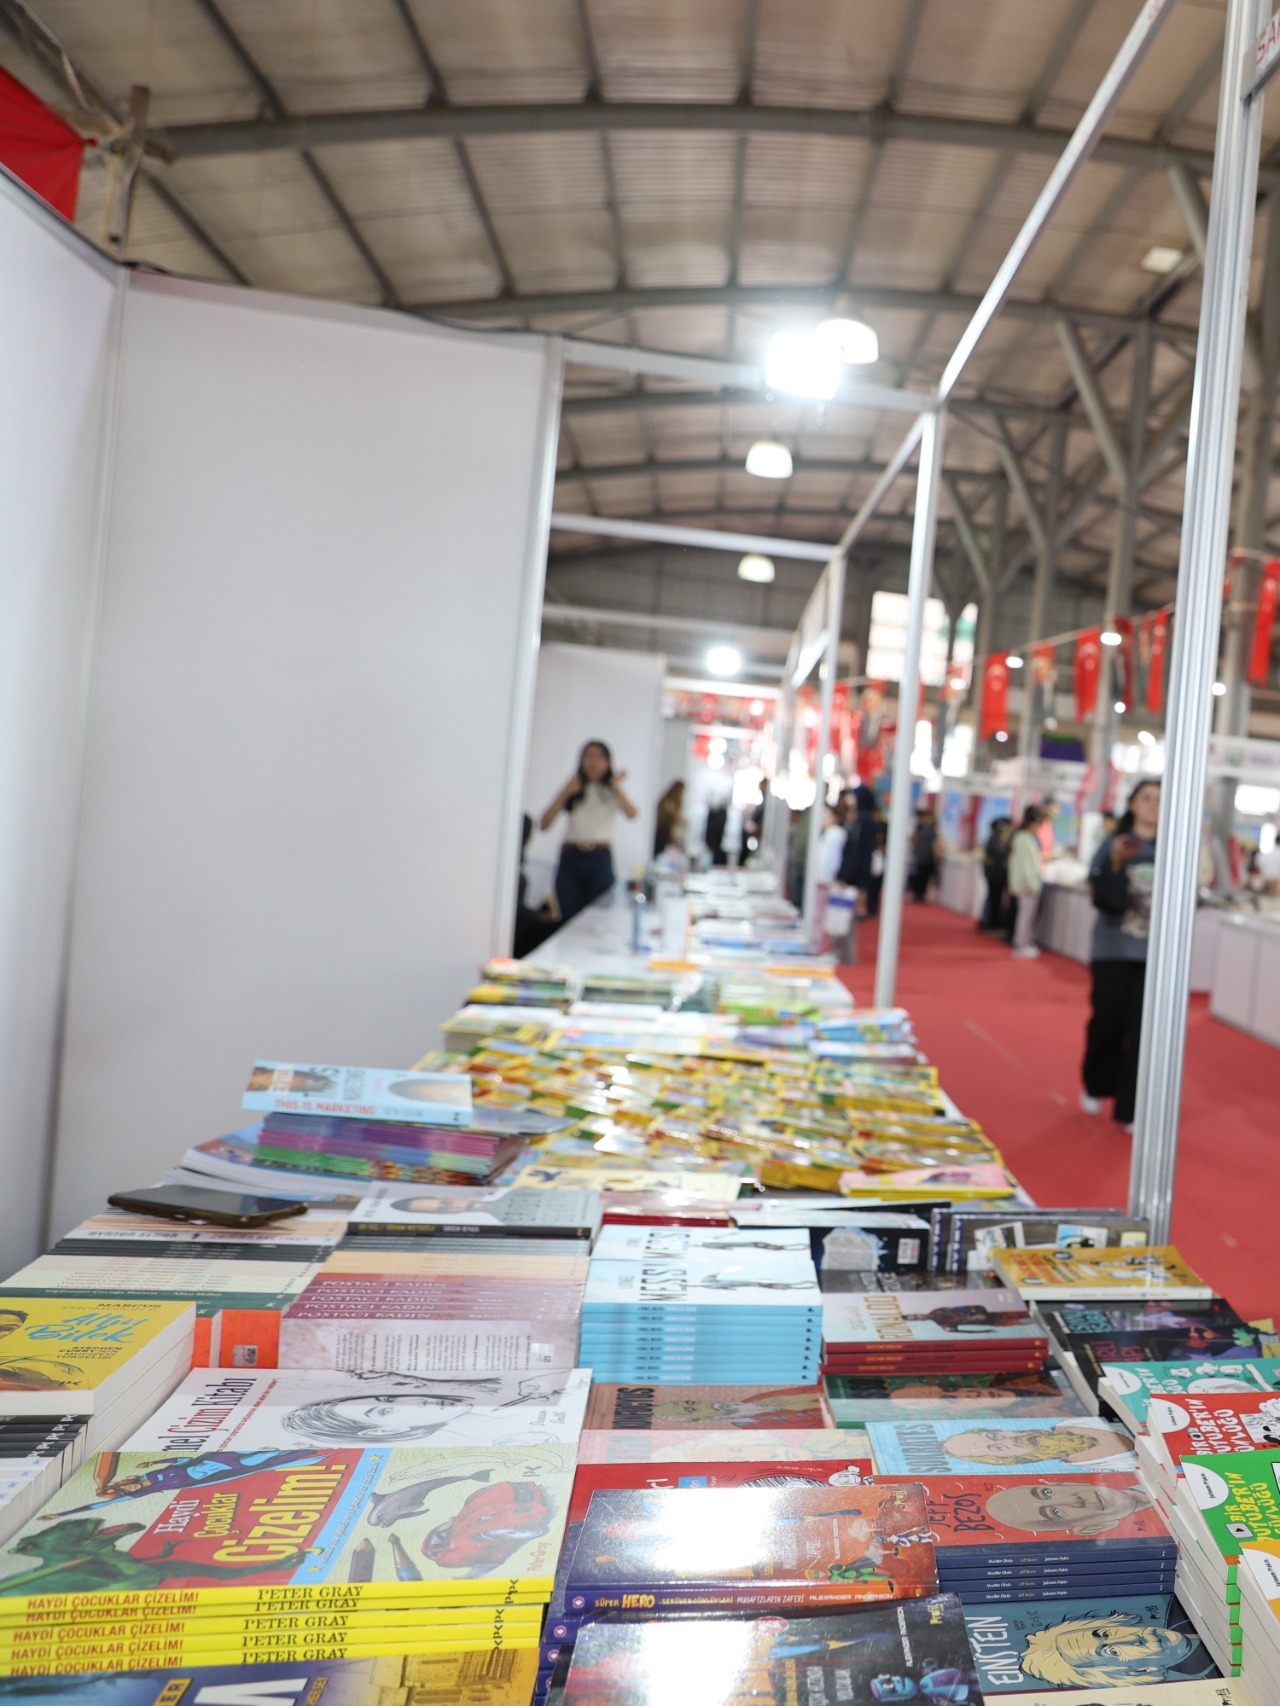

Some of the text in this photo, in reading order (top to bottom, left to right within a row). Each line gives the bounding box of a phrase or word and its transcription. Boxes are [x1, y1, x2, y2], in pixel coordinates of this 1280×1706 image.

[316, 1102, 377, 1115] MARKETING
[191, 1377, 257, 1406] Kitabı
[167, 1408, 234, 1434] Çizim
[1185, 1398, 1231, 1455] UTUBER'IN
[1215, 1408, 1255, 1452] ÜNLÜĞÜ
[154, 1498, 200, 1535] Haydi
[193, 1492, 240, 1538] Çocuklar
[213, 1464, 349, 1562] Çizelim!
[949, 1492, 995, 1533] BEZOS
[1224, 1471, 1274, 1542] OUTUBER'IN
[1224, 1504, 1248, 1523] BİR
[27, 1591, 199, 1610] HAYDİ ÇOCUKLAR ÇİZELİM!
[258, 1586, 363, 1600] PETER GRAY
[622, 1594, 655, 1609] HERO
[809, 1593, 852, 1601] ALEXANDER
[854, 1592, 893, 1600] ANDERSON
[13, 1622, 185, 1642] HAYDİ ÇOCUKLAR ÇİZELİM!
[244, 1615, 349, 1630] PETER GRAY
[11, 1639, 183, 1660] HAYDİ ÇOCUKLAR ÇİZELİM!
[242, 1632, 348, 1647] PETER GRAY
[242, 1648, 348, 1663] PETER GRAY
[964, 1615, 1024, 1686] EINSTEIN
[10, 1661, 50, 1676] HAYDİ
